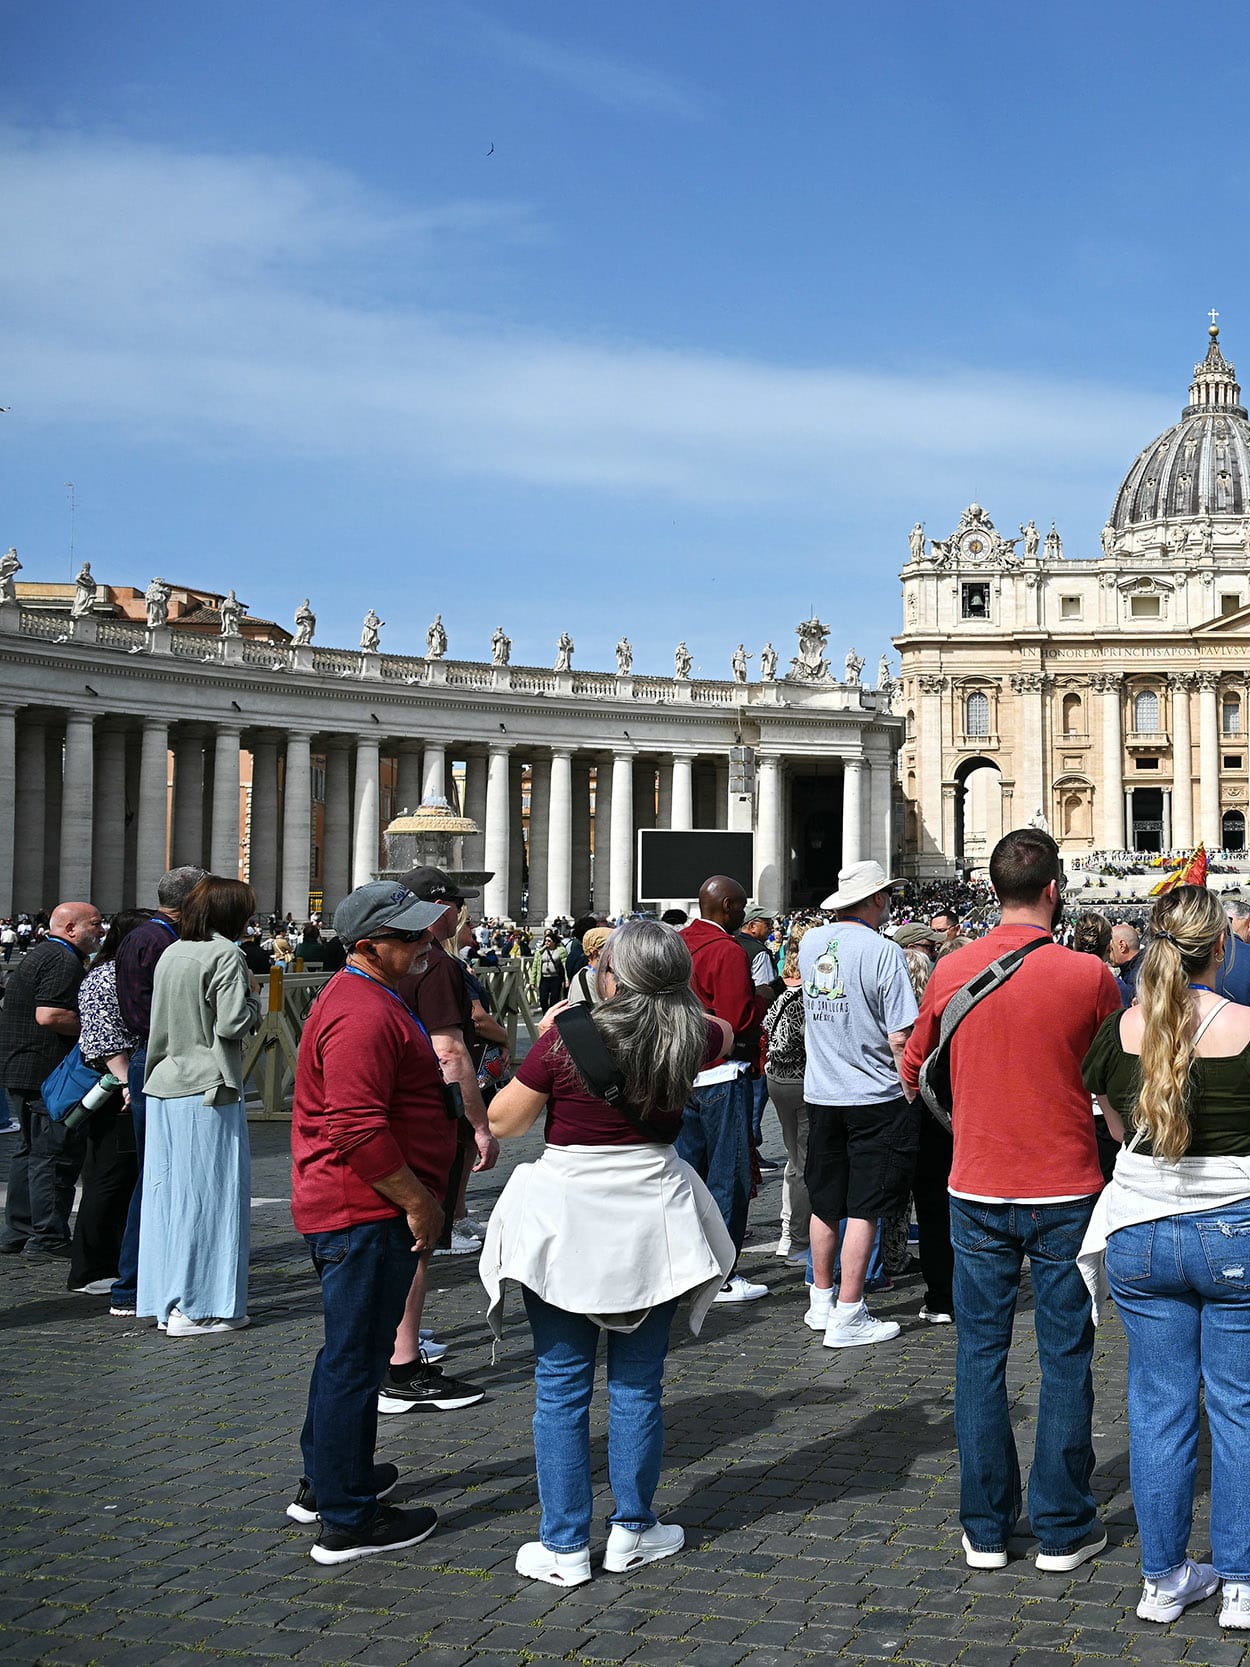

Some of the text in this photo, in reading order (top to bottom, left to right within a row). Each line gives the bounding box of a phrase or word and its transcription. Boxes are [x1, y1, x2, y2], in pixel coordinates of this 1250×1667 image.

[1022, 647, 1036, 657] IN
[1041, 648, 1100, 658] HONOREM
[1103, 647, 1161, 657] PRINCIPIS
[1201, 646, 1239, 656] PAVLVS
